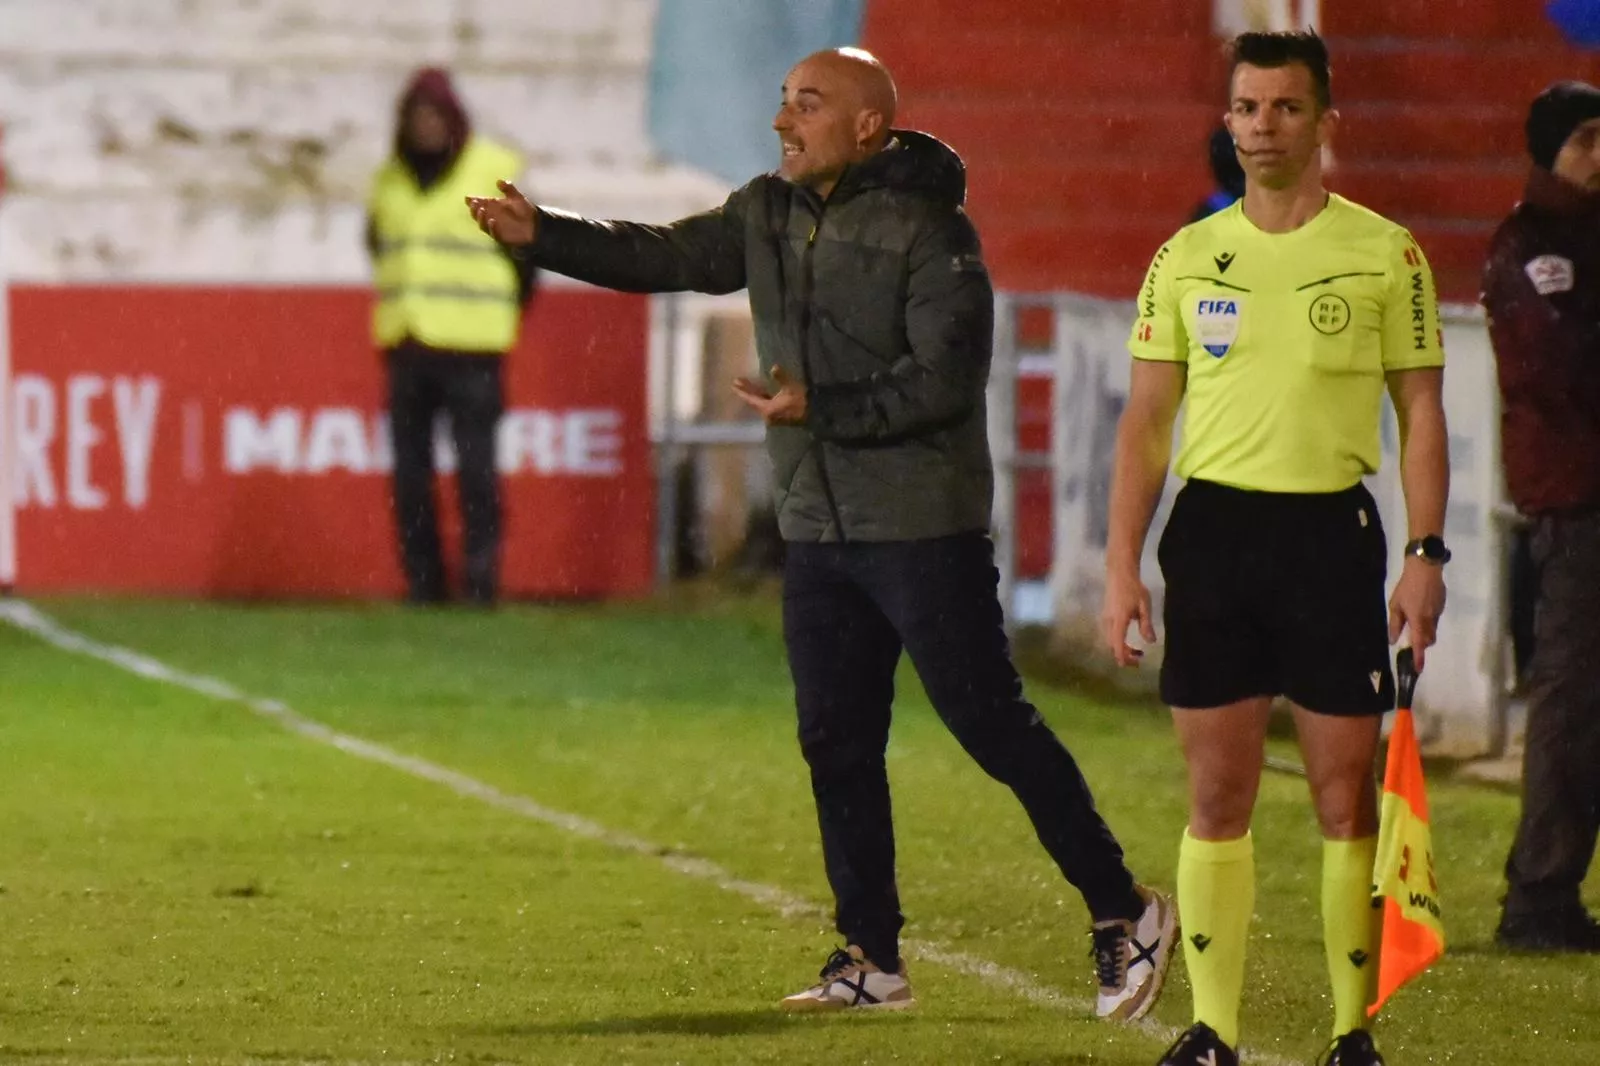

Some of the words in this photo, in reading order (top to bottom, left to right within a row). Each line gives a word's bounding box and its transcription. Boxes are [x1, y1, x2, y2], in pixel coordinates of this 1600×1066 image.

[1198, 300, 1237, 314] FIFA
[15, 372, 161, 509] REY
[222, 406, 622, 475] MARE
